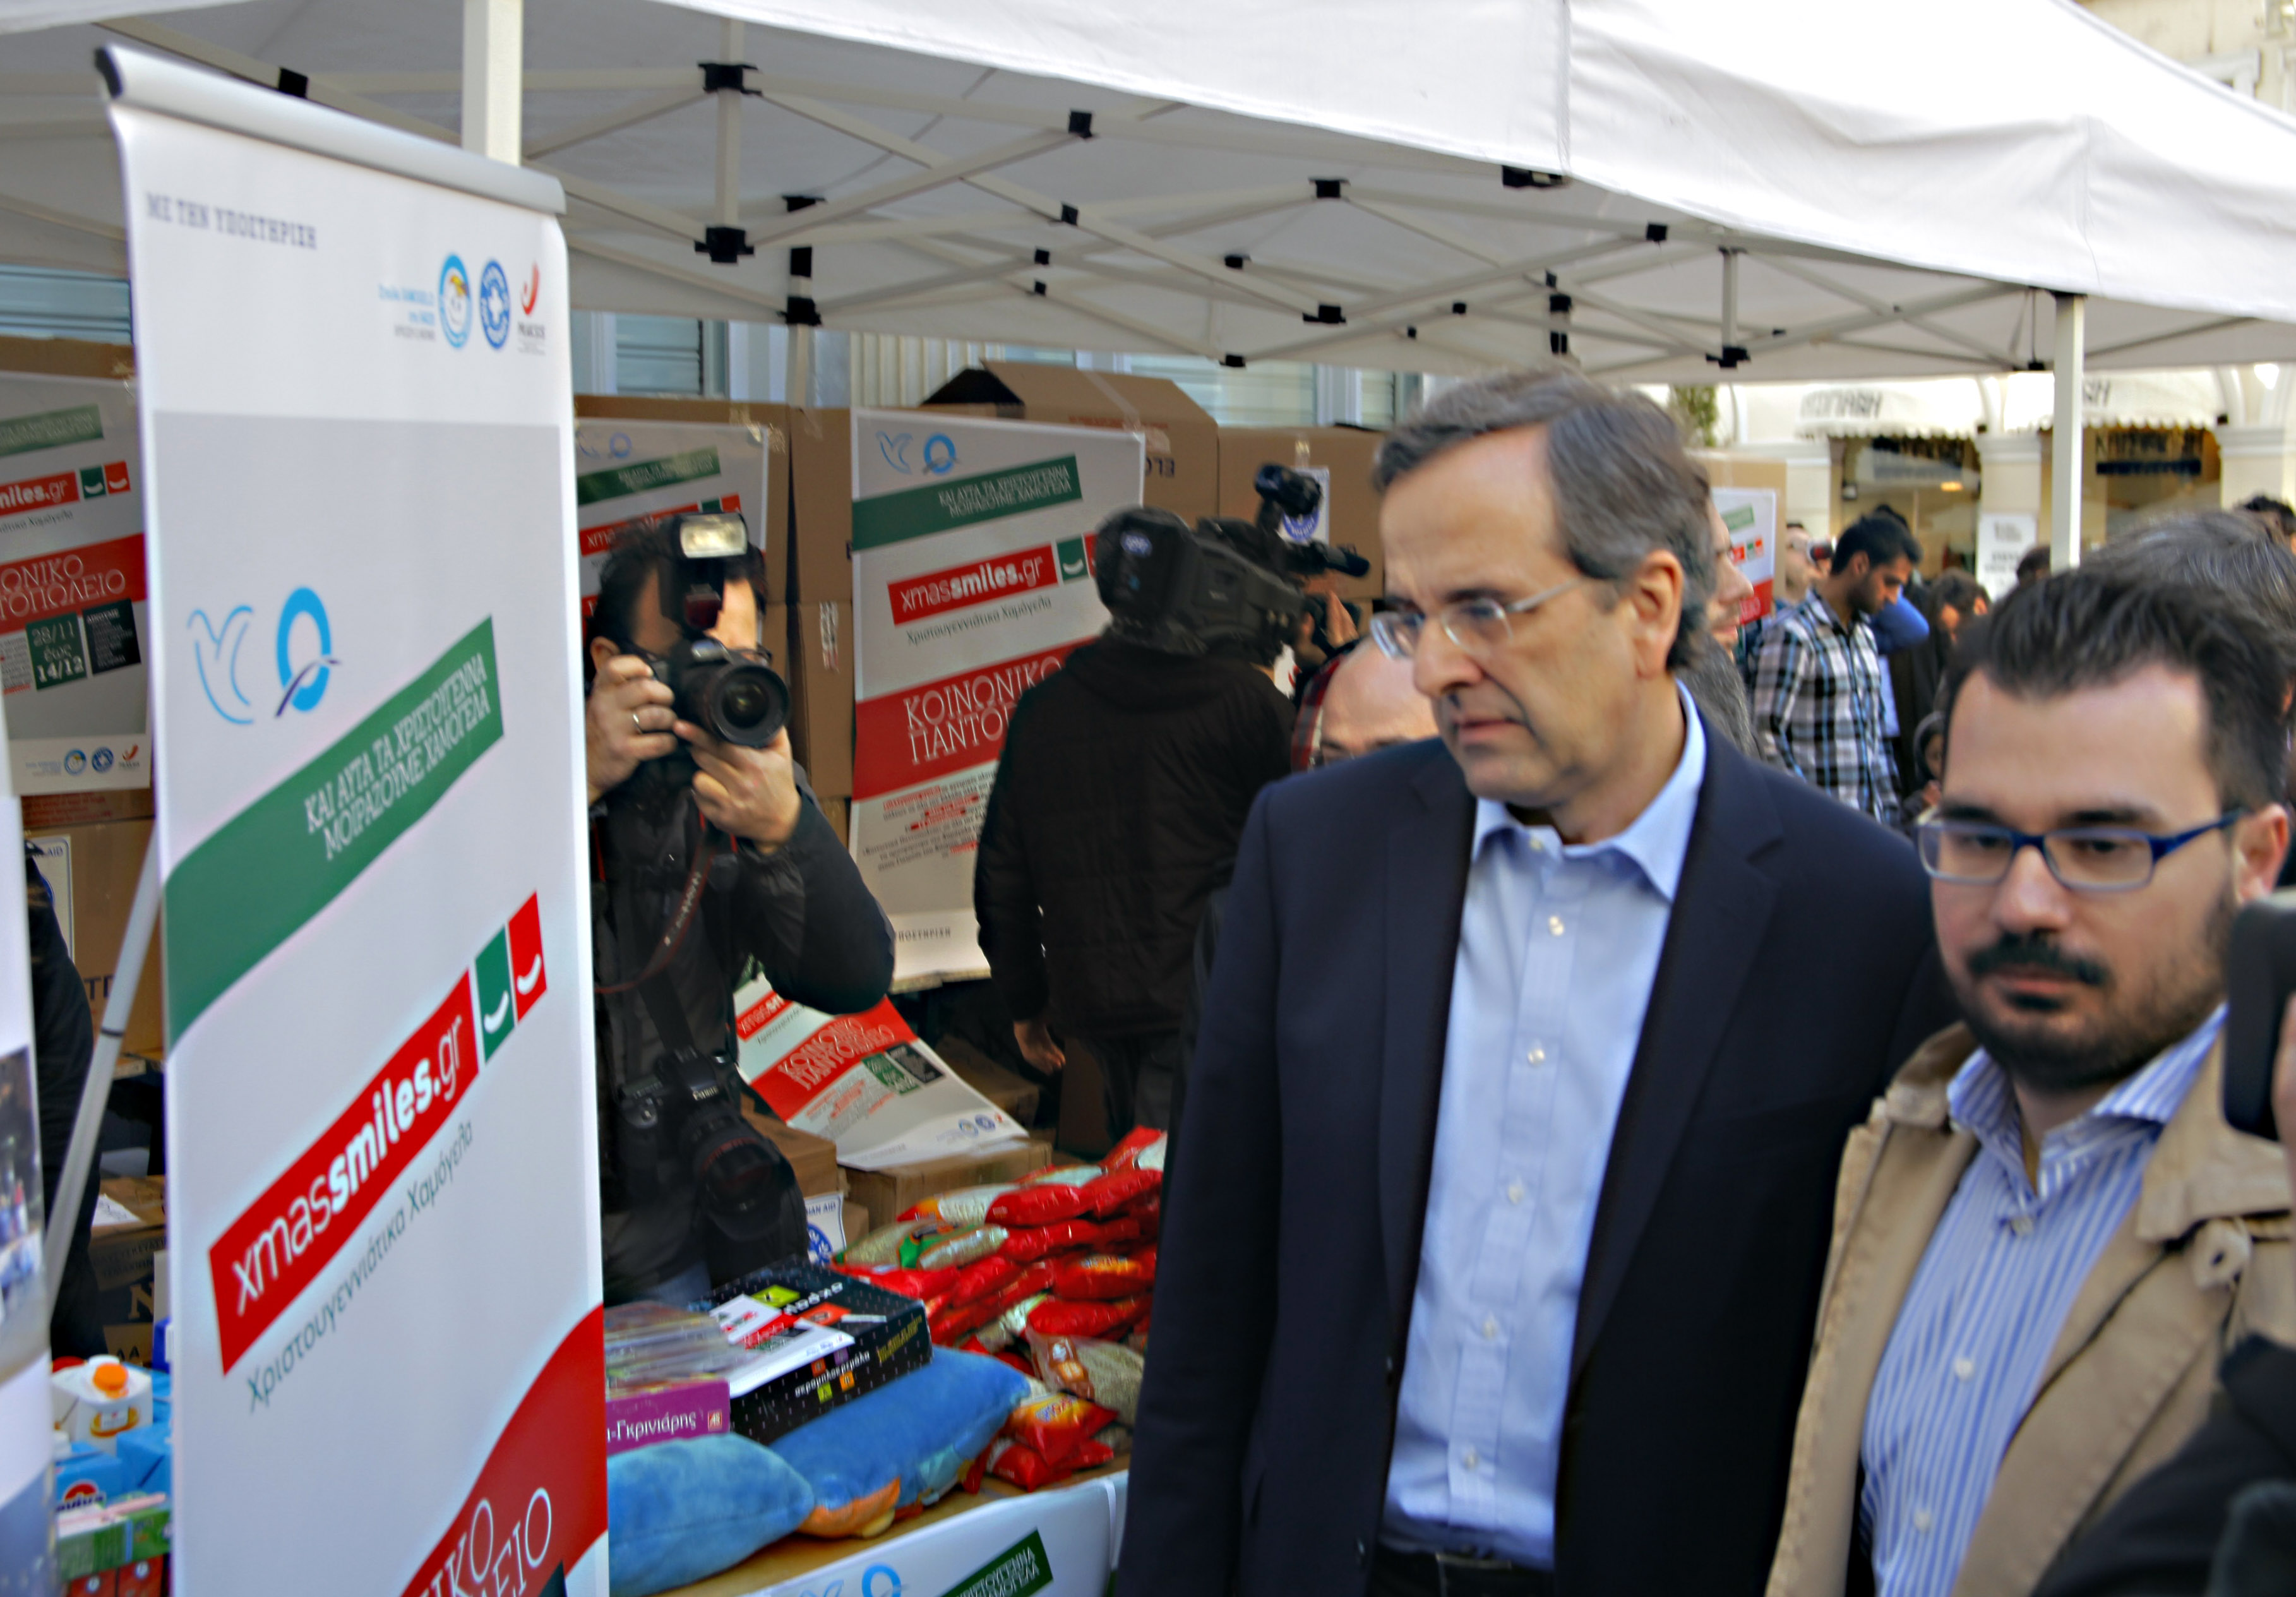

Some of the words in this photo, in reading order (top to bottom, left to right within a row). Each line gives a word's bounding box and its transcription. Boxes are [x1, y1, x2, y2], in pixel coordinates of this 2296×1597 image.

[900, 555, 1044, 614] xmassmiles.gr
[304, 781, 335, 834] ΚΑΙ
[337, 751, 374, 810] ΑΥΤΑ
[372, 733, 396, 774] ΤΑ
[393, 652, 487, 759] ΧΡΙΣΤΟΥΓΕΝΝΑ
[323, 745, 426, 861] ΜΟΙΡΑΖΟΥΜΕ
[424, 685, 491, 772] ΧΑΜΟΓΕΛΑ
[231, 1014, 463, 1319] xmassmiles.gr
[248, 1207, 406, 1414] Χριστουγεννιάτικα
[407, 1120, 473, 1222] Χαμόγελα
[491, 1486, 553, 1597] ΕΙΟ
